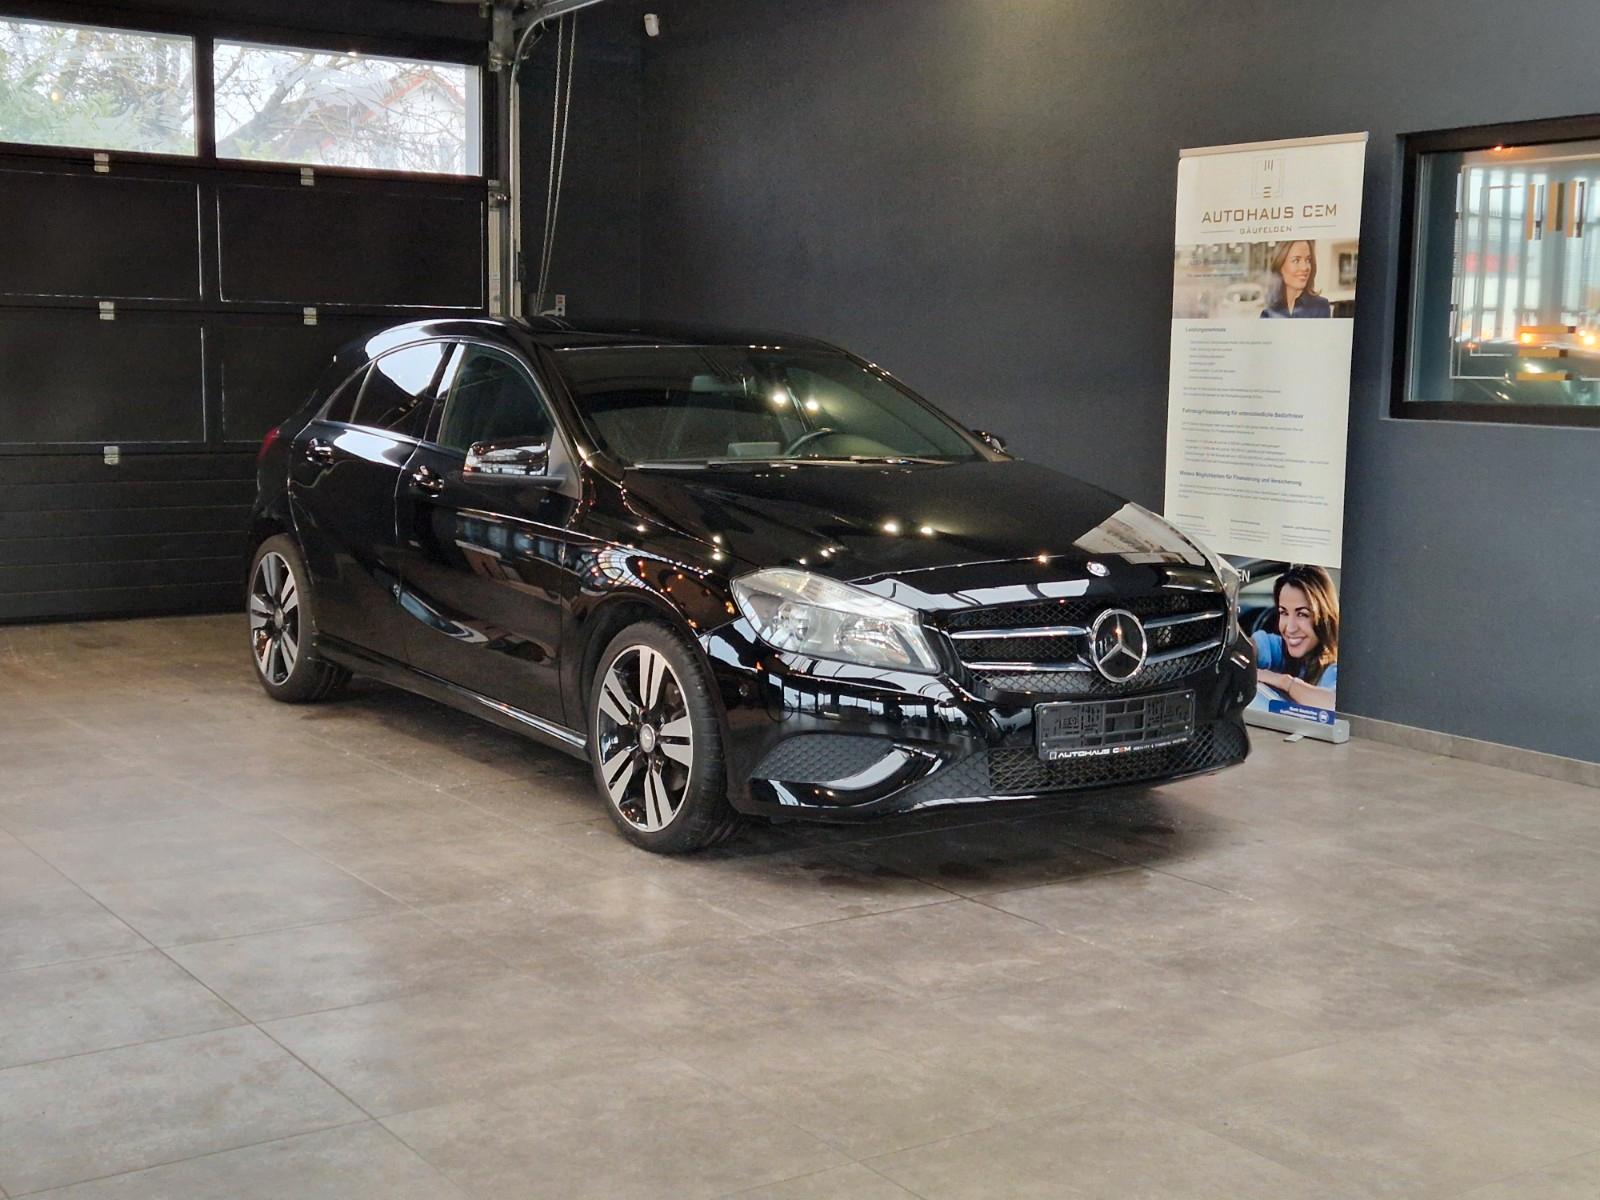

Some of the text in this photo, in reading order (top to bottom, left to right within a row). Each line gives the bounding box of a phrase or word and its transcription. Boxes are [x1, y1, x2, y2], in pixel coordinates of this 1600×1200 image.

[1201, 203, 1338, 224] AUTOHAUS CEM
[1058, 748, 1110, 759] AUTOHAUS
